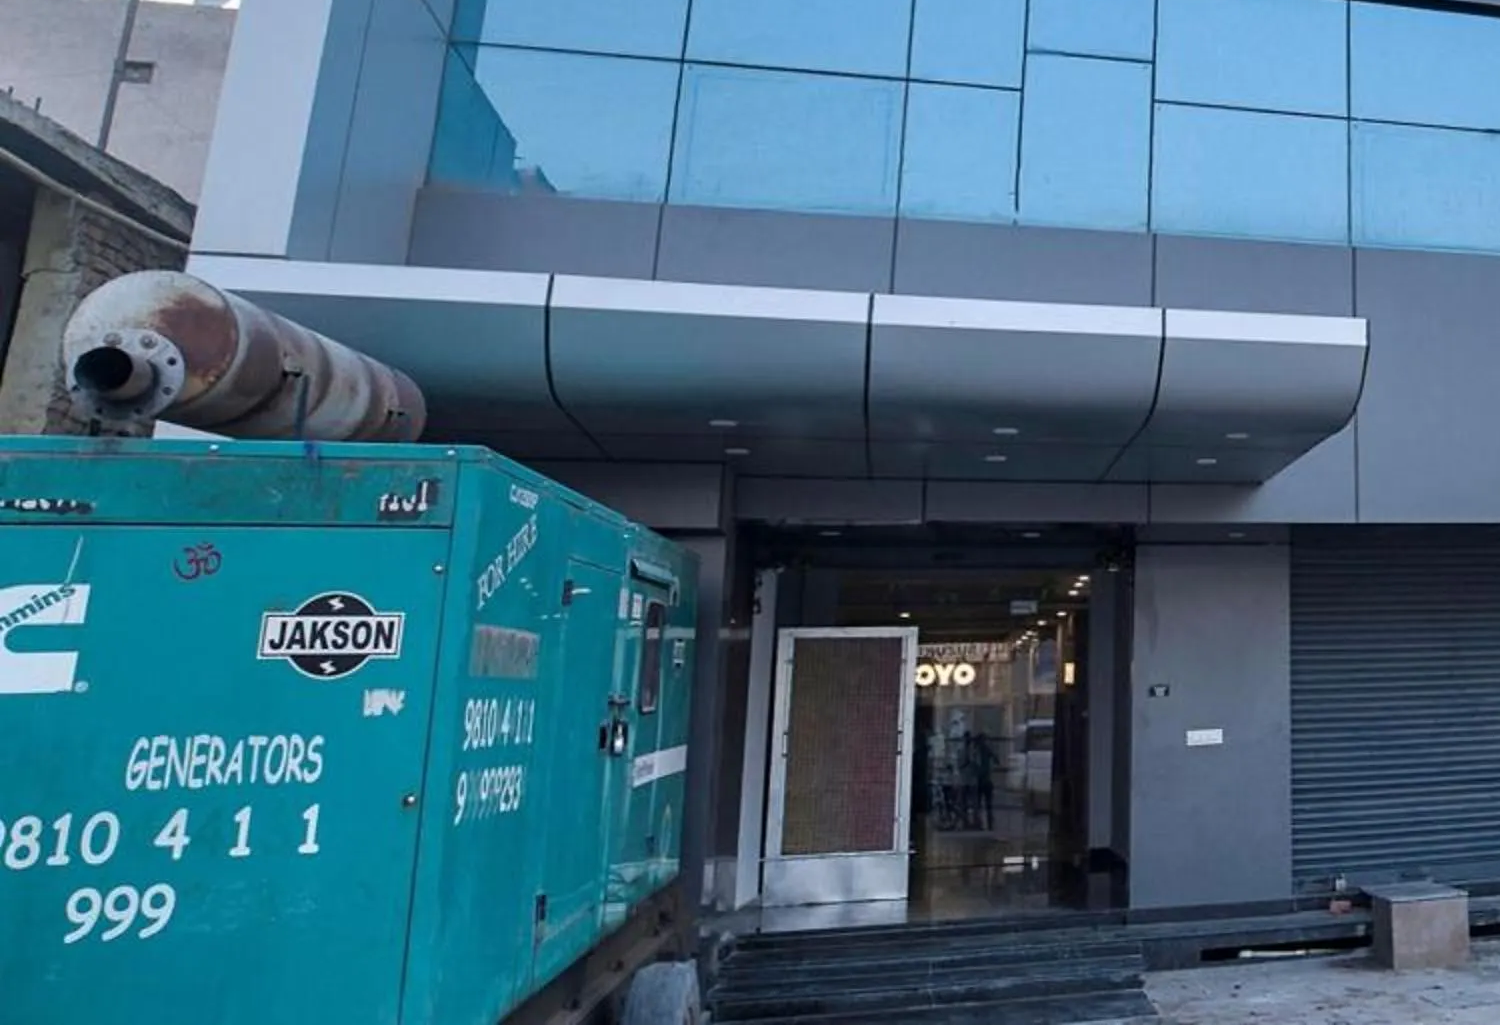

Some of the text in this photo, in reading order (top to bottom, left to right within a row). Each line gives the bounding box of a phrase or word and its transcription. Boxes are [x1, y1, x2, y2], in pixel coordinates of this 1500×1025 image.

[268, 620, 396, 652] JAKSON
[915, 662, 976, 686] OYO
[125, 733, 325, 790] GENERATORS
[0, 803, 320, 869] 810 4 1 1
[64, 883, 176, 943] 999
